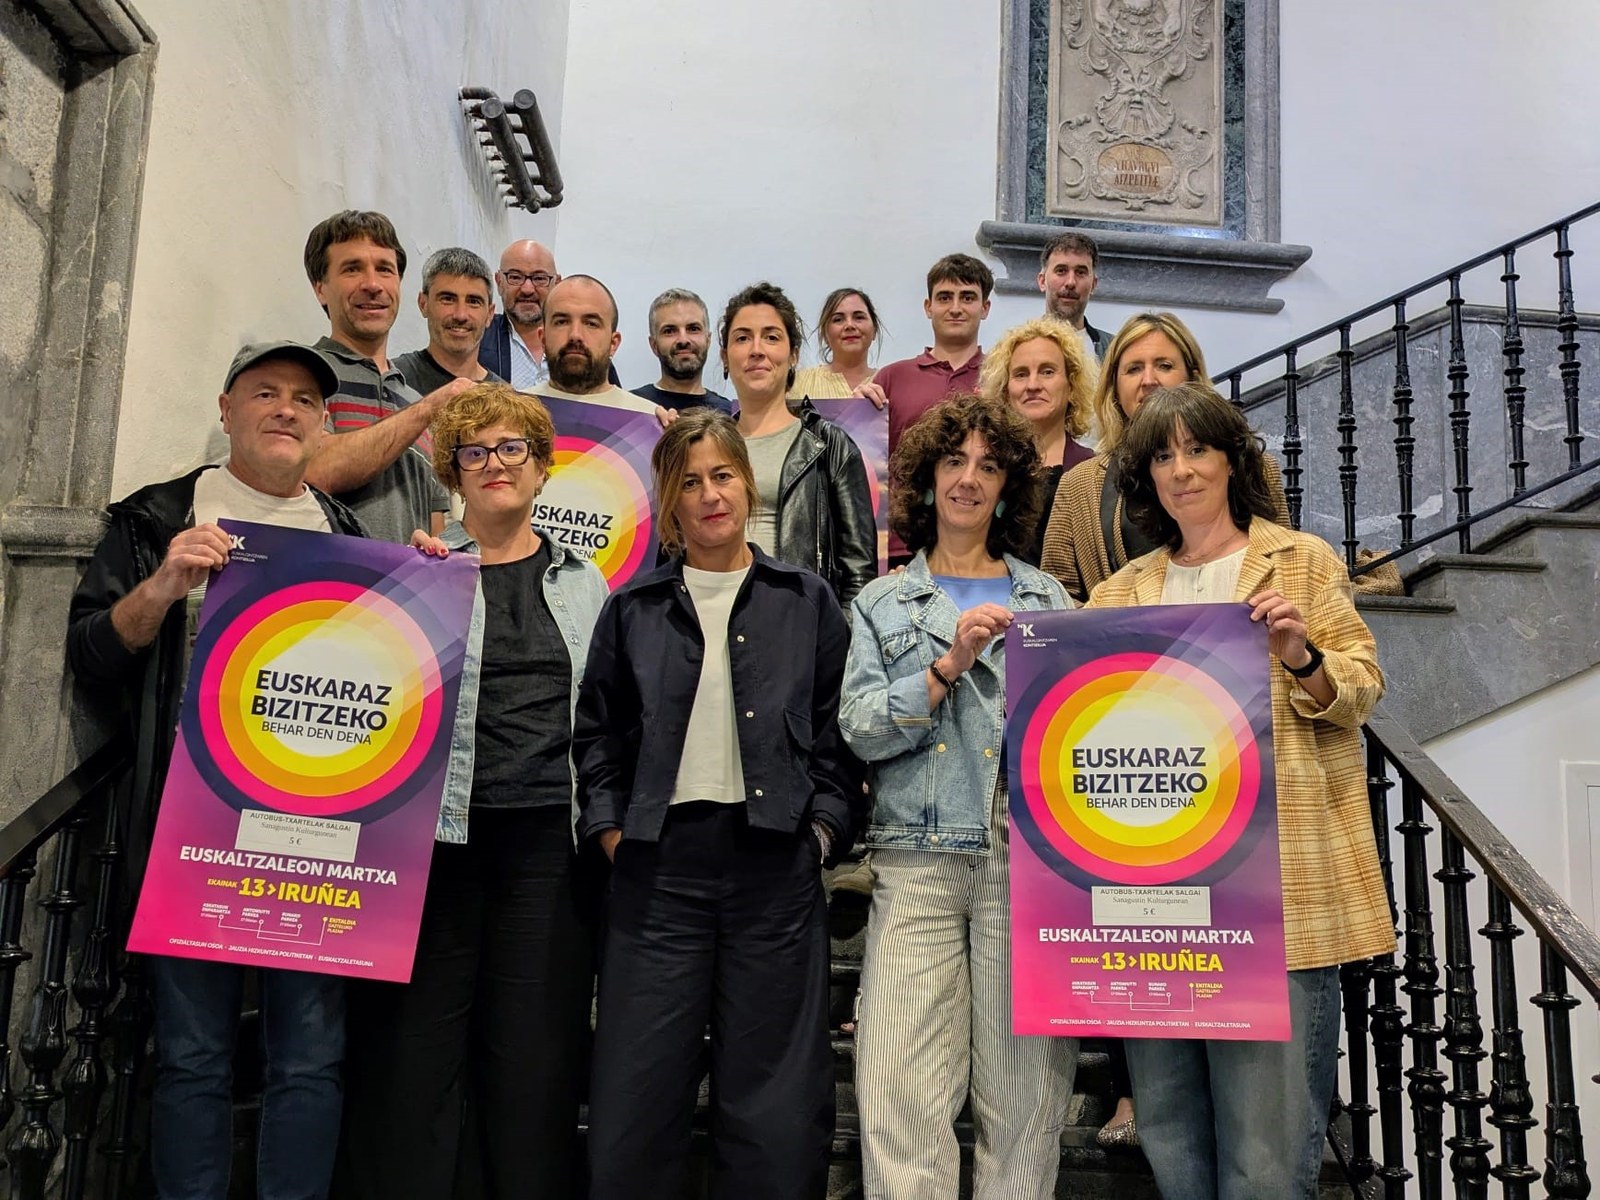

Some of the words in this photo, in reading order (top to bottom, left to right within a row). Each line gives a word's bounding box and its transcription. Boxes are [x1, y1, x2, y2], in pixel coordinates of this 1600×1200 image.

[531, 504, 614, 530] SKARAZ
[531, 523, 610, 550] TZEKO
[255, 670, 392, 706] EUSKARAZ
[250, 695, 388, 732] BIZITZEKO
[261, 720, 304, 738] BEHAR
[306, 726, 334, 740] DEN
[336, 730, 372, 746] DENA
[1072, 747, 1206, 768] EUSKARAZ
[1073, 772, 1208, 794] BIZITZEKO
[1086, 797, 1128, 808] BEHAR
[1131, 797, 1158, 808] DEN
[1161, 797, 1196, 808] DENA
[250, 812, 324, 828] AUTOBUS-TXARTELAK
[326, 822, 352, 832] SALGAI
[288, 836, 294, 845] 5
[296, 838, 302, 846] €
[180, 846, 326, 877] EUSKALTZALEON
[326, 864, 398, 886] MARTXA
[207, 878, 238, 888] EKAINAK
[238, 876, 265, 898] 13
[278, 881, 361, 910] IRUÑEA
[1039, 928, 1177, 943] EUSKALTZALEON
[1182, 929, 1254, 944] MARTXA
[1102, 952, 1125, 970] 13
[1140, 949, 1223, 972] IRUÑEA
